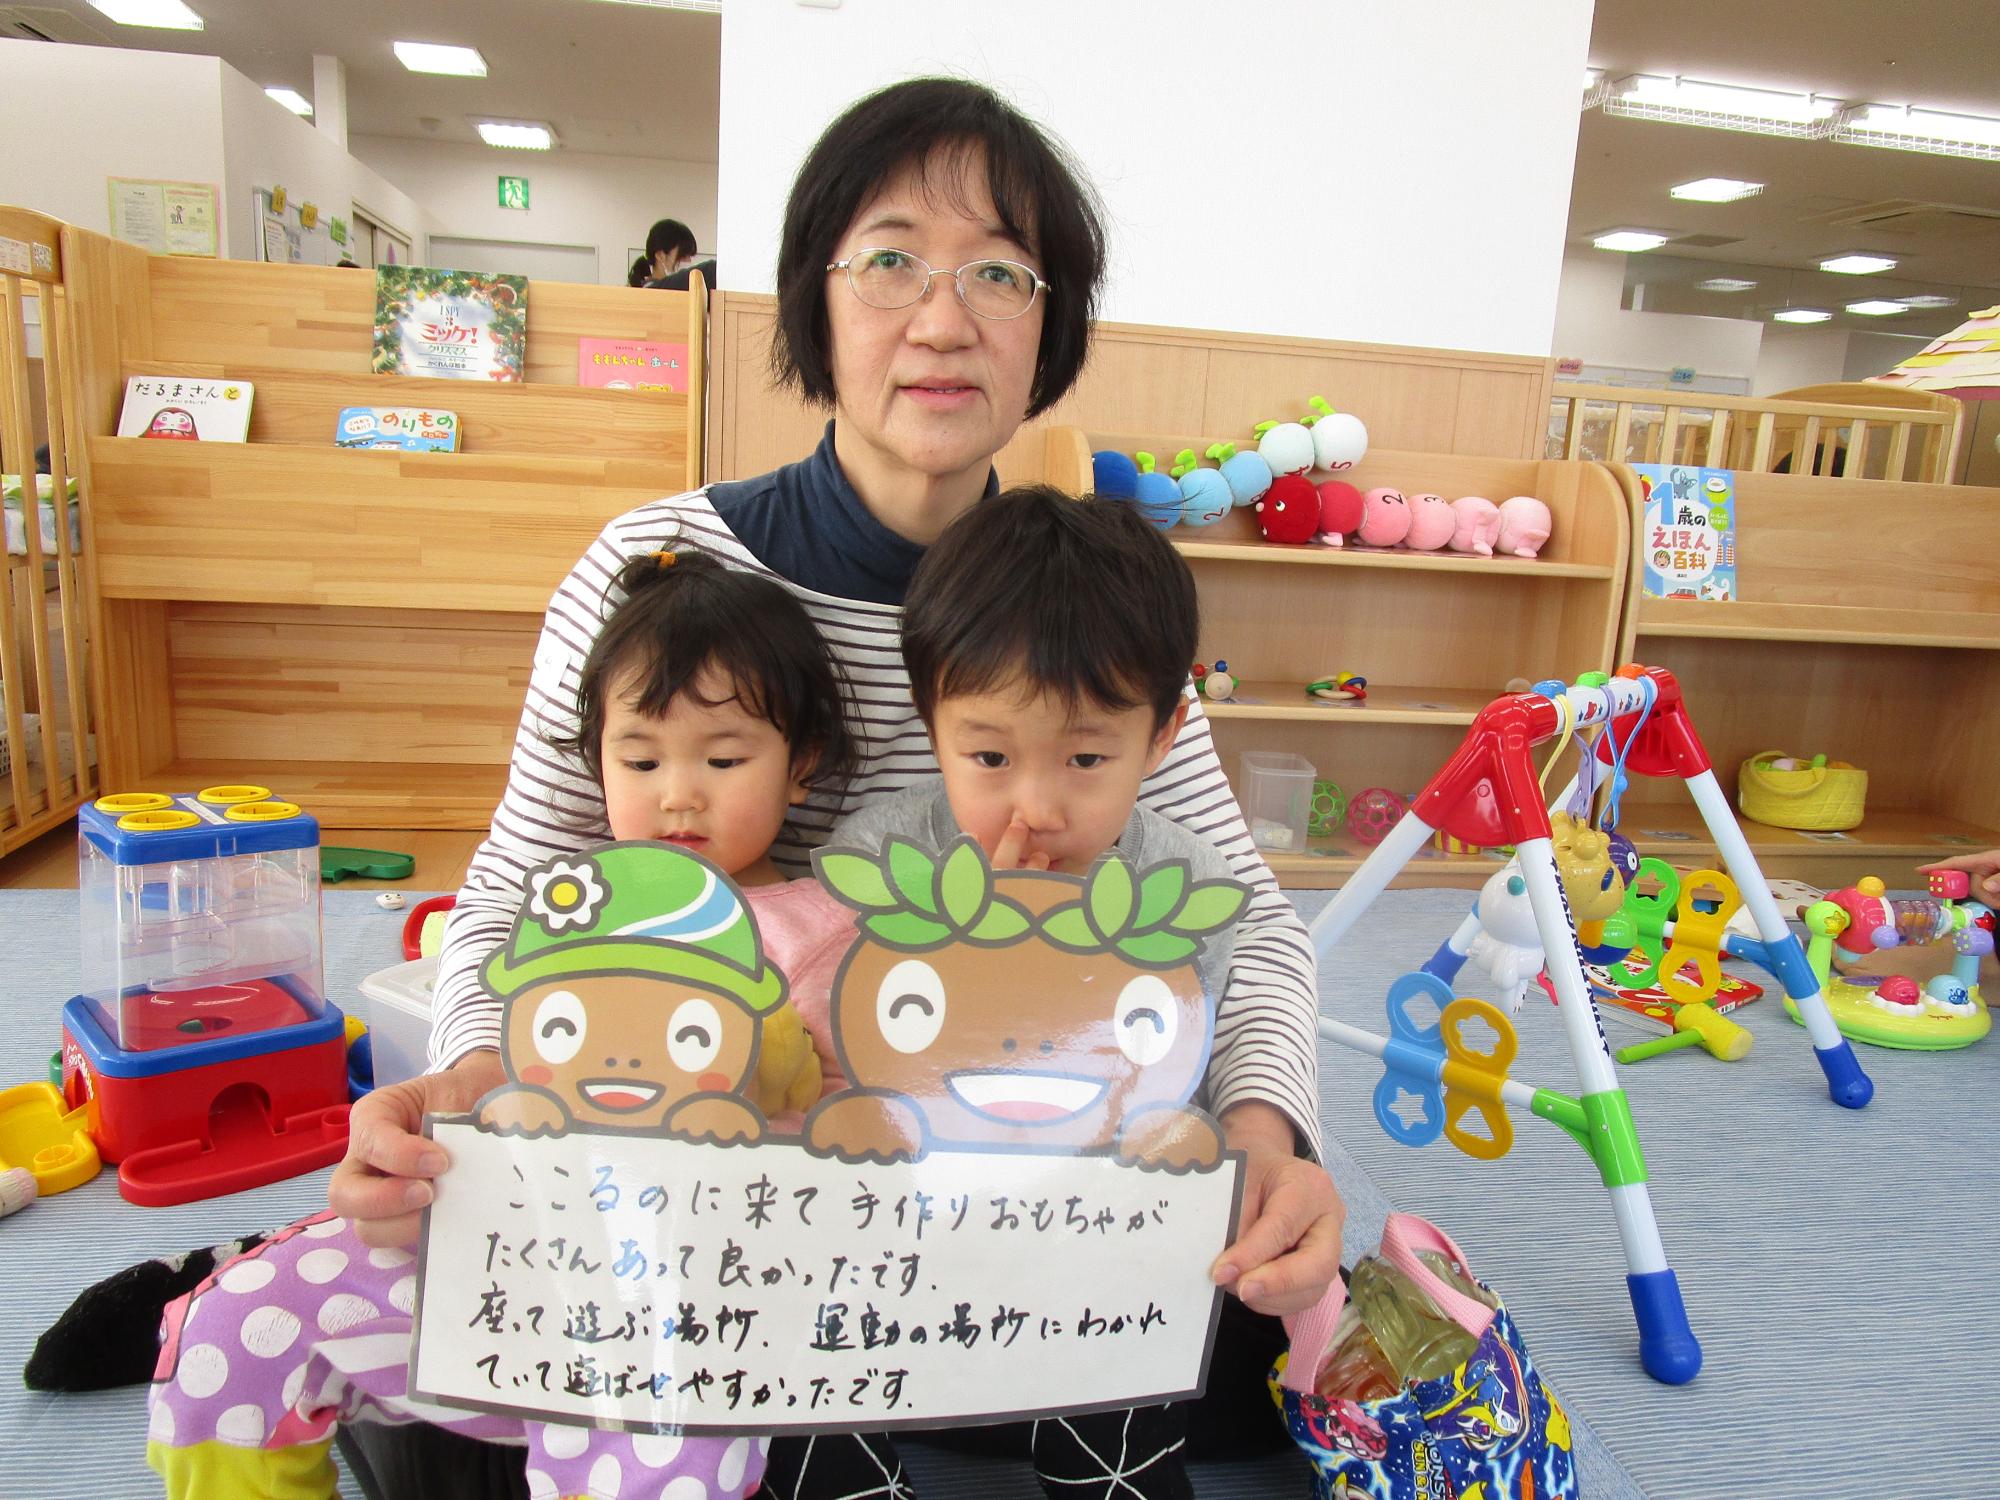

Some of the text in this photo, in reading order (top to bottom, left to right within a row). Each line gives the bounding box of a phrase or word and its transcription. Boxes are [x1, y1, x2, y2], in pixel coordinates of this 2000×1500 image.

[428, 344, 467, 356] クリスマス
[135, 382, 239, 400] だるまさんと
[382, 411, 454, 432] のりもの
[1381, 493, 1404, 504] 2
[1652, 526, 1711, 551] えほん
[1673, 551, 1707, 570] 百科
[1412, 1440, 1427, 1472] SUN
[1421, 1431, 1446, 1500] MONS
